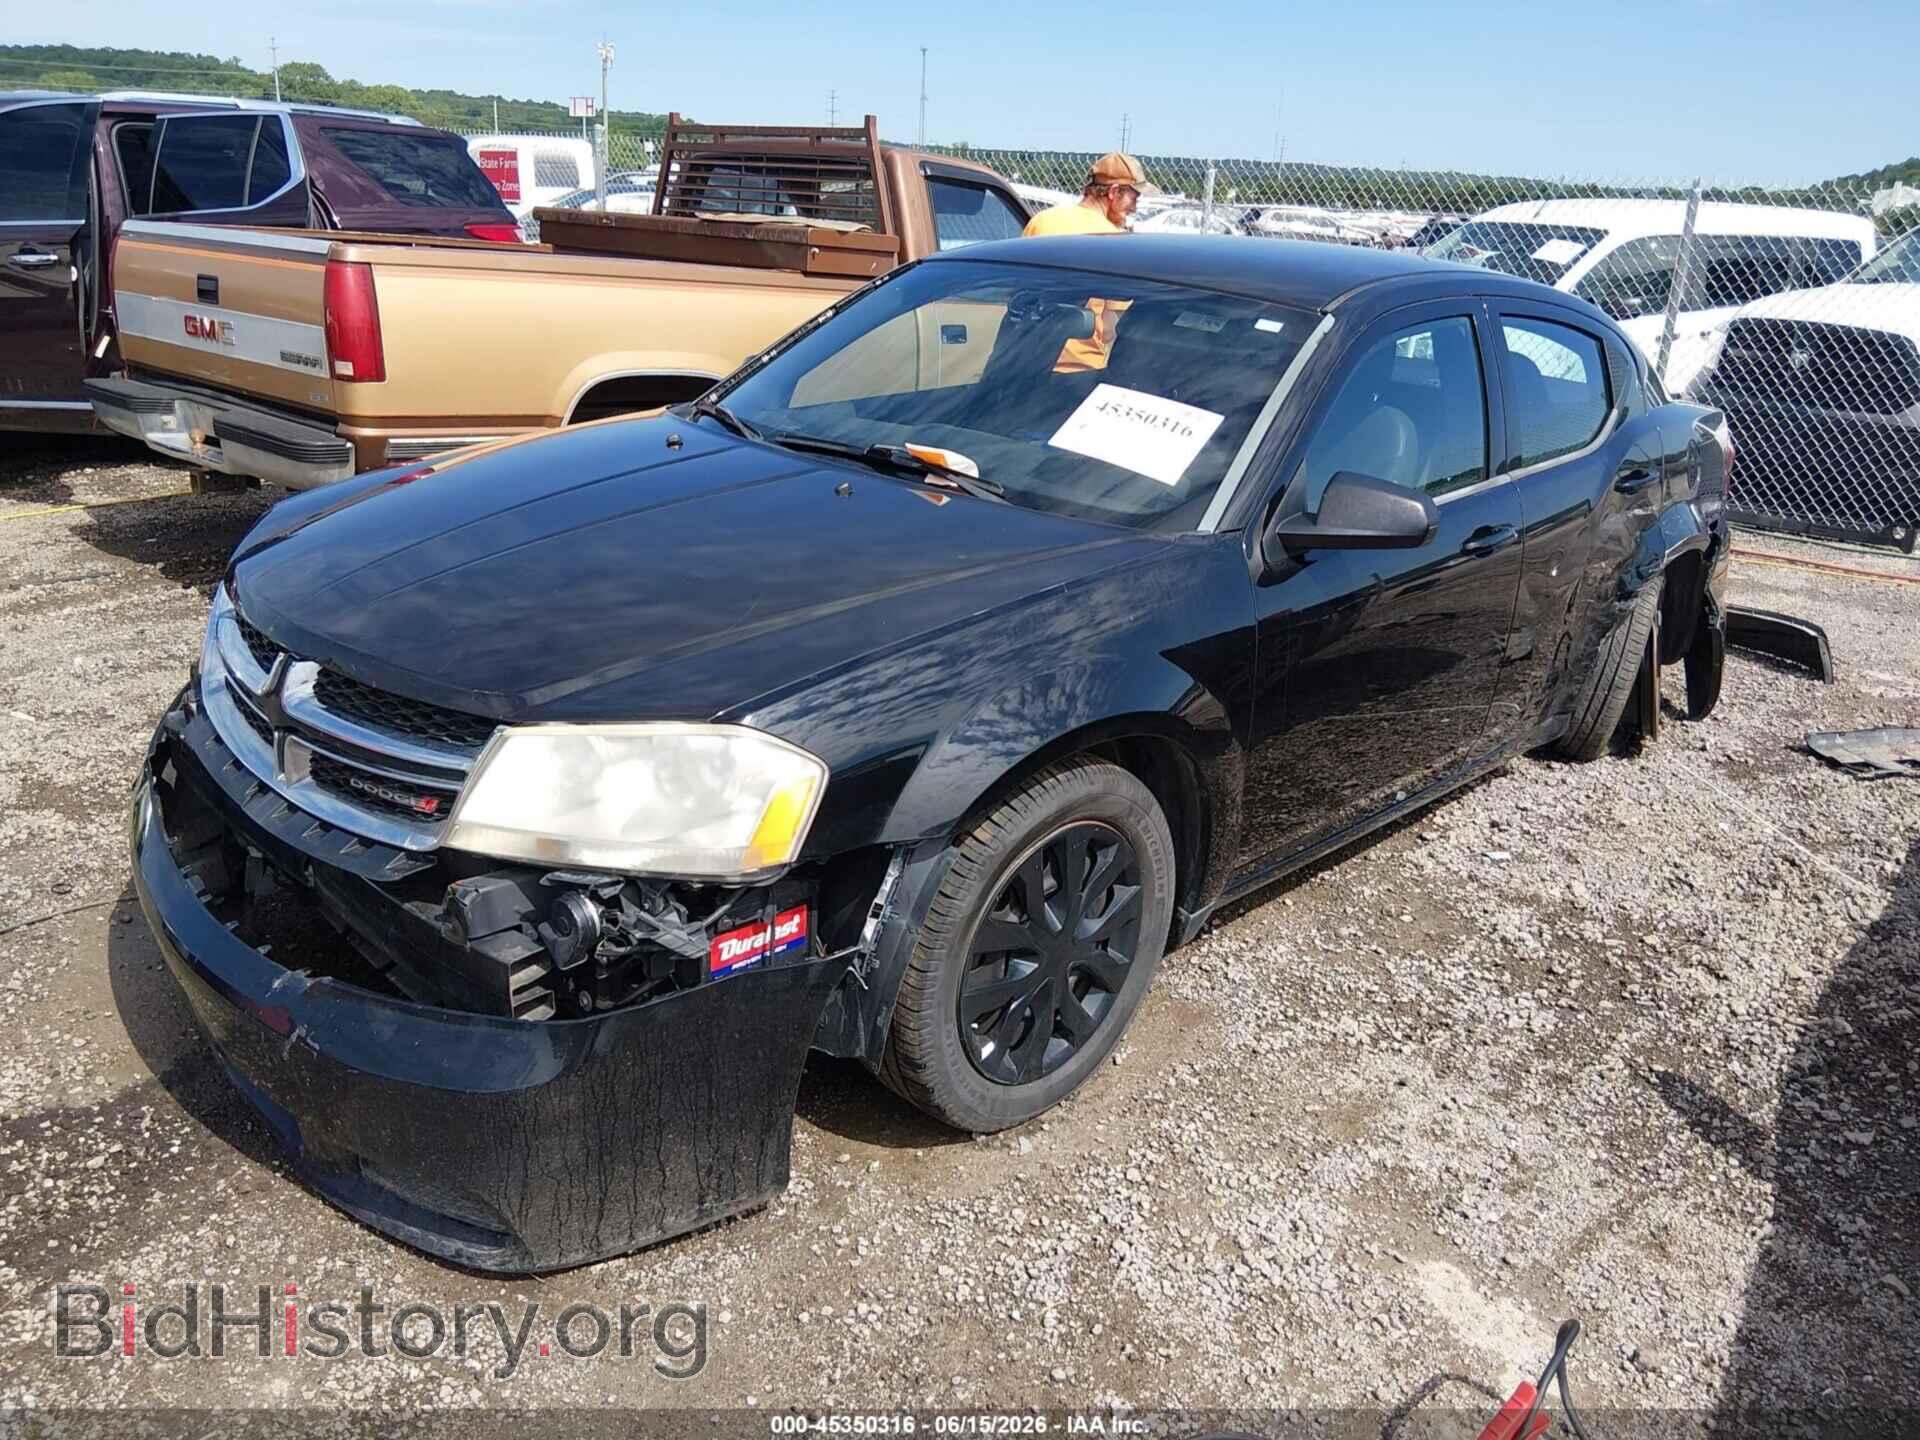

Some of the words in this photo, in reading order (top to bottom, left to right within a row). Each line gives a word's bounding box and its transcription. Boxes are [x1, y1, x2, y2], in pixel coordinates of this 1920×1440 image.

[499, 156, 518, 169] Farm
[184, 314, 236, 346] GMC
[350, 778, 417, 809] DODGE
